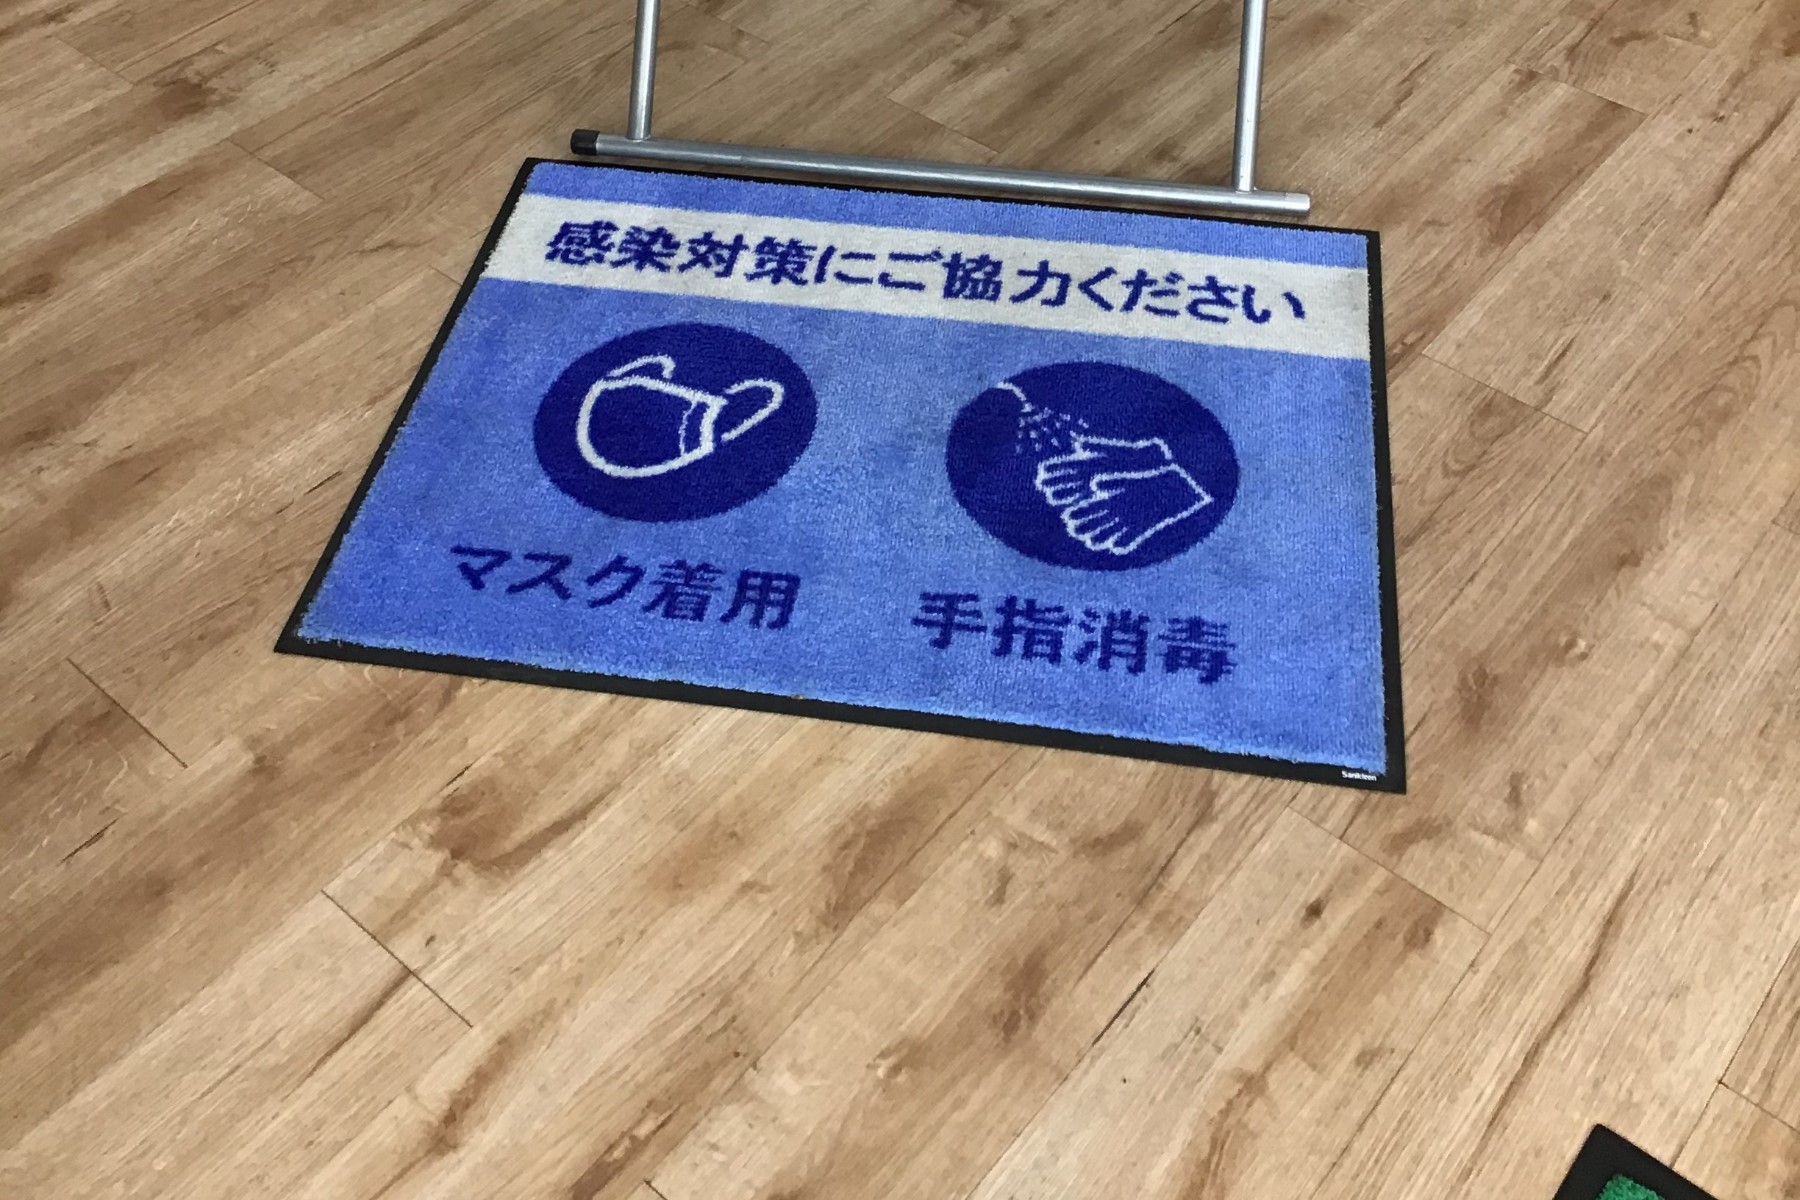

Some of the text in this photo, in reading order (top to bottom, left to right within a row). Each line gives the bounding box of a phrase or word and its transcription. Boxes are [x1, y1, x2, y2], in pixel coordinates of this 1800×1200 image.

[545, 220, 1306, 326] 感染対策にご協力ください
[449, 544, 801, 631] マスク着用
[911, 591, 1237, 685] 手指消毒
